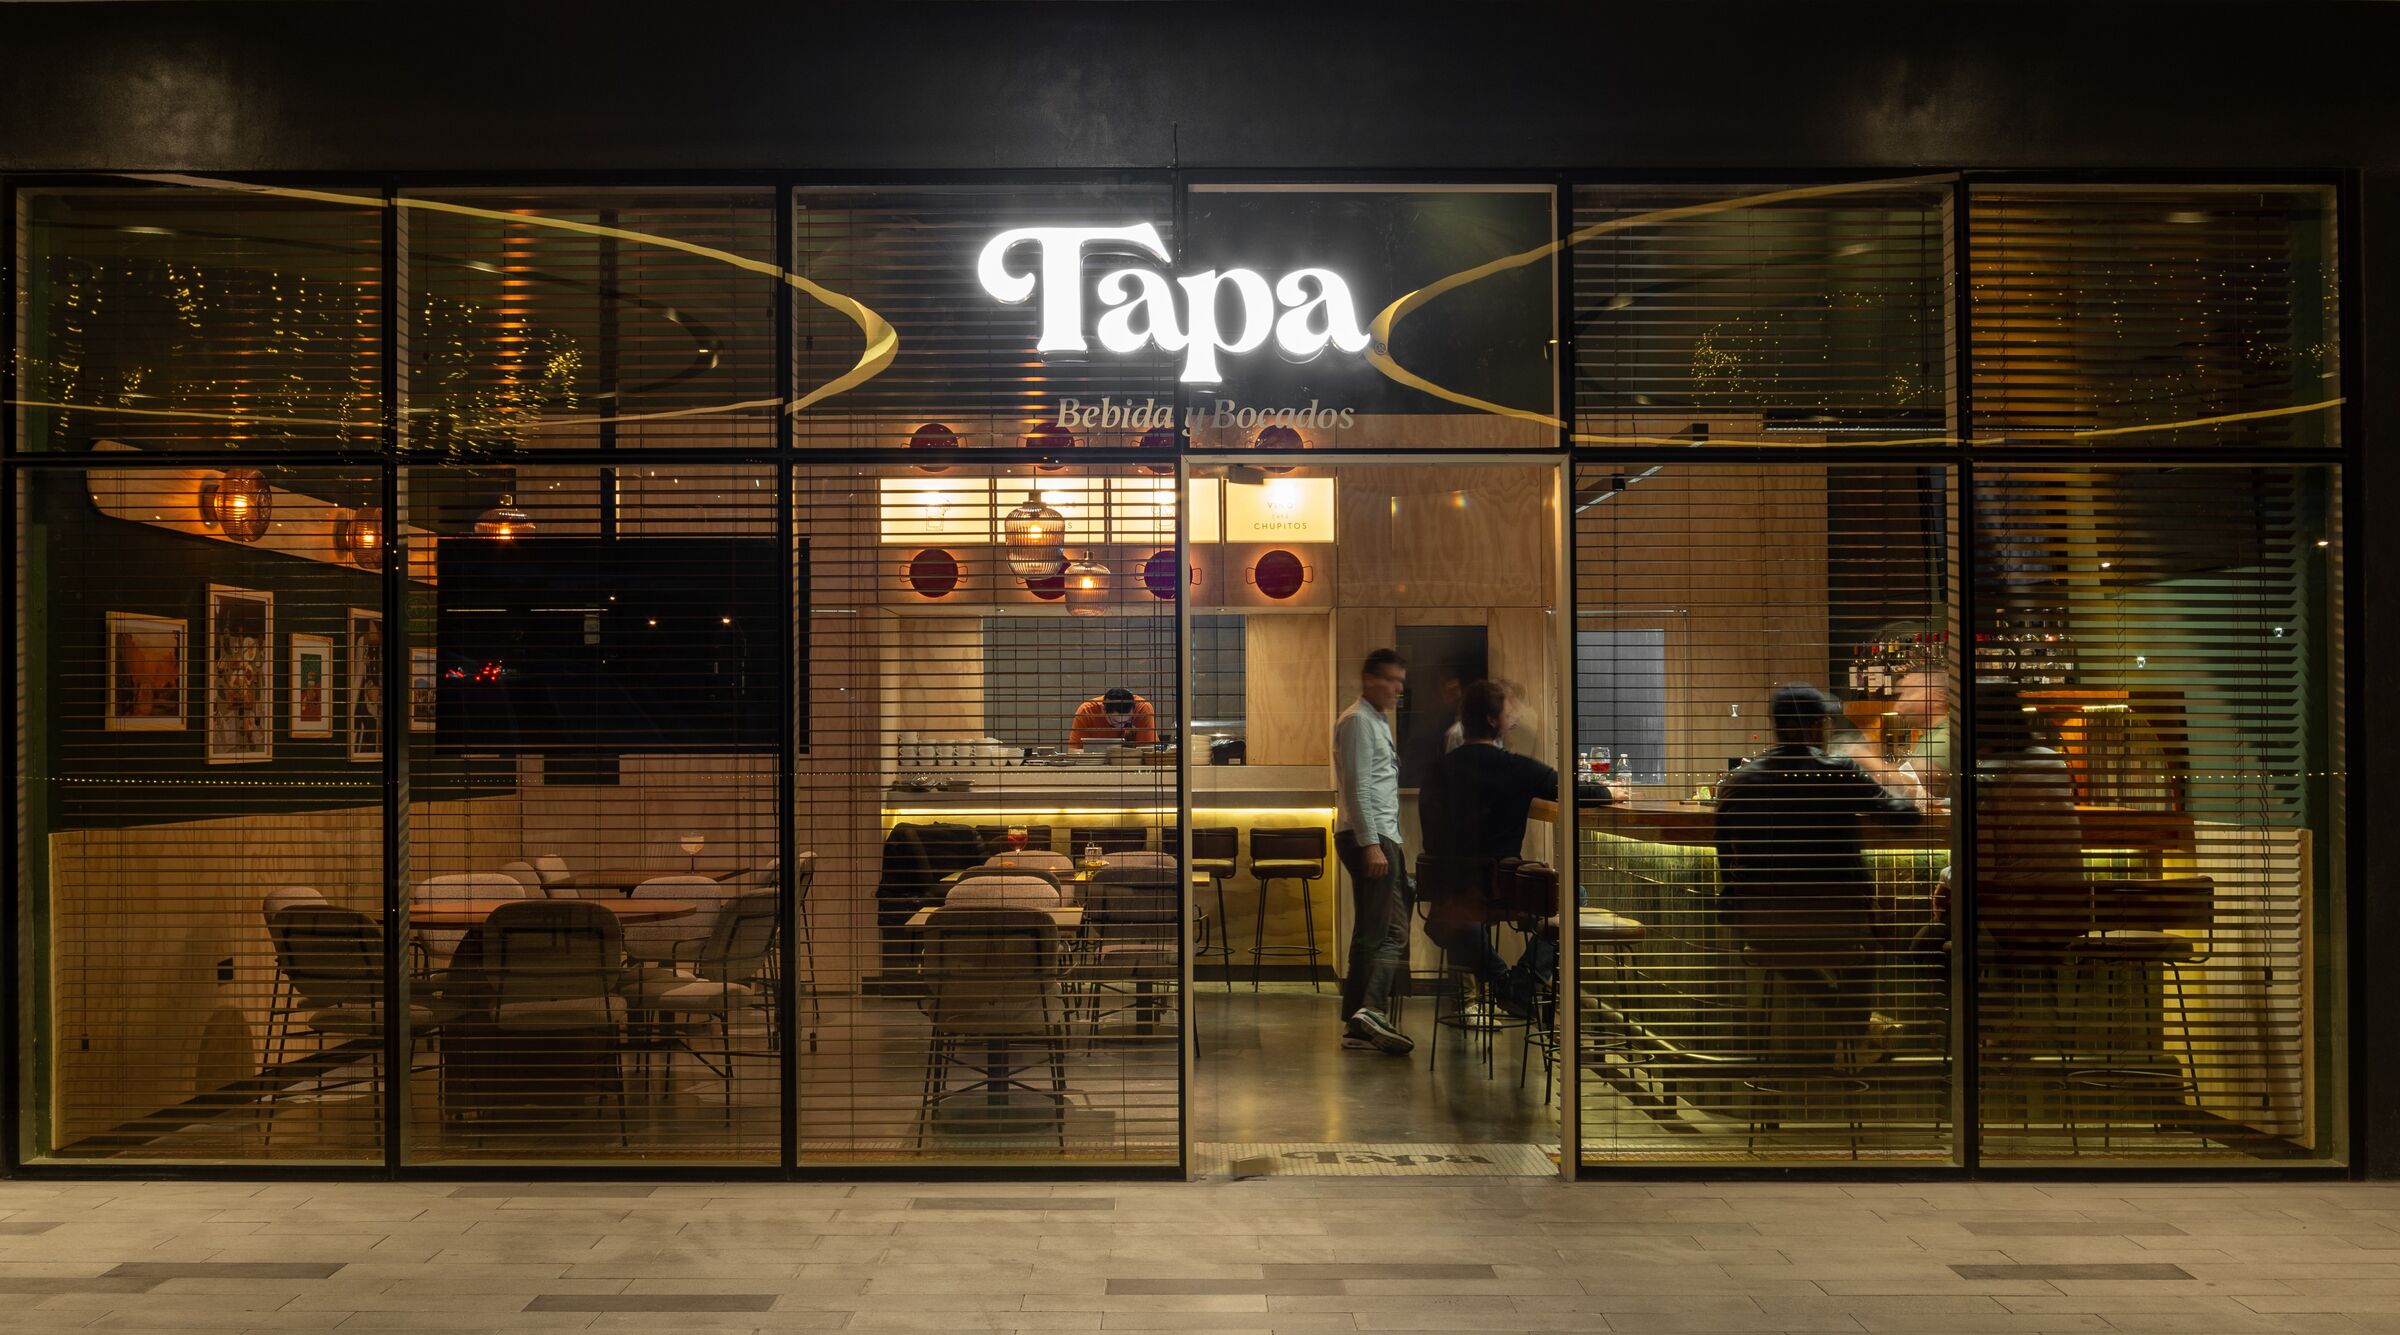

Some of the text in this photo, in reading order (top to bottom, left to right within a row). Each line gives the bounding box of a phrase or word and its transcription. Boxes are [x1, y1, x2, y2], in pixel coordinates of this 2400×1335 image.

[977, 222, 1371, 383] Tapa
[1055, 398, 1355, 437] Bebida y Bocados
[1253, 522, 1308, 530] CHUPITOS
[1281, 1150, 1493, 1167] Tapa
